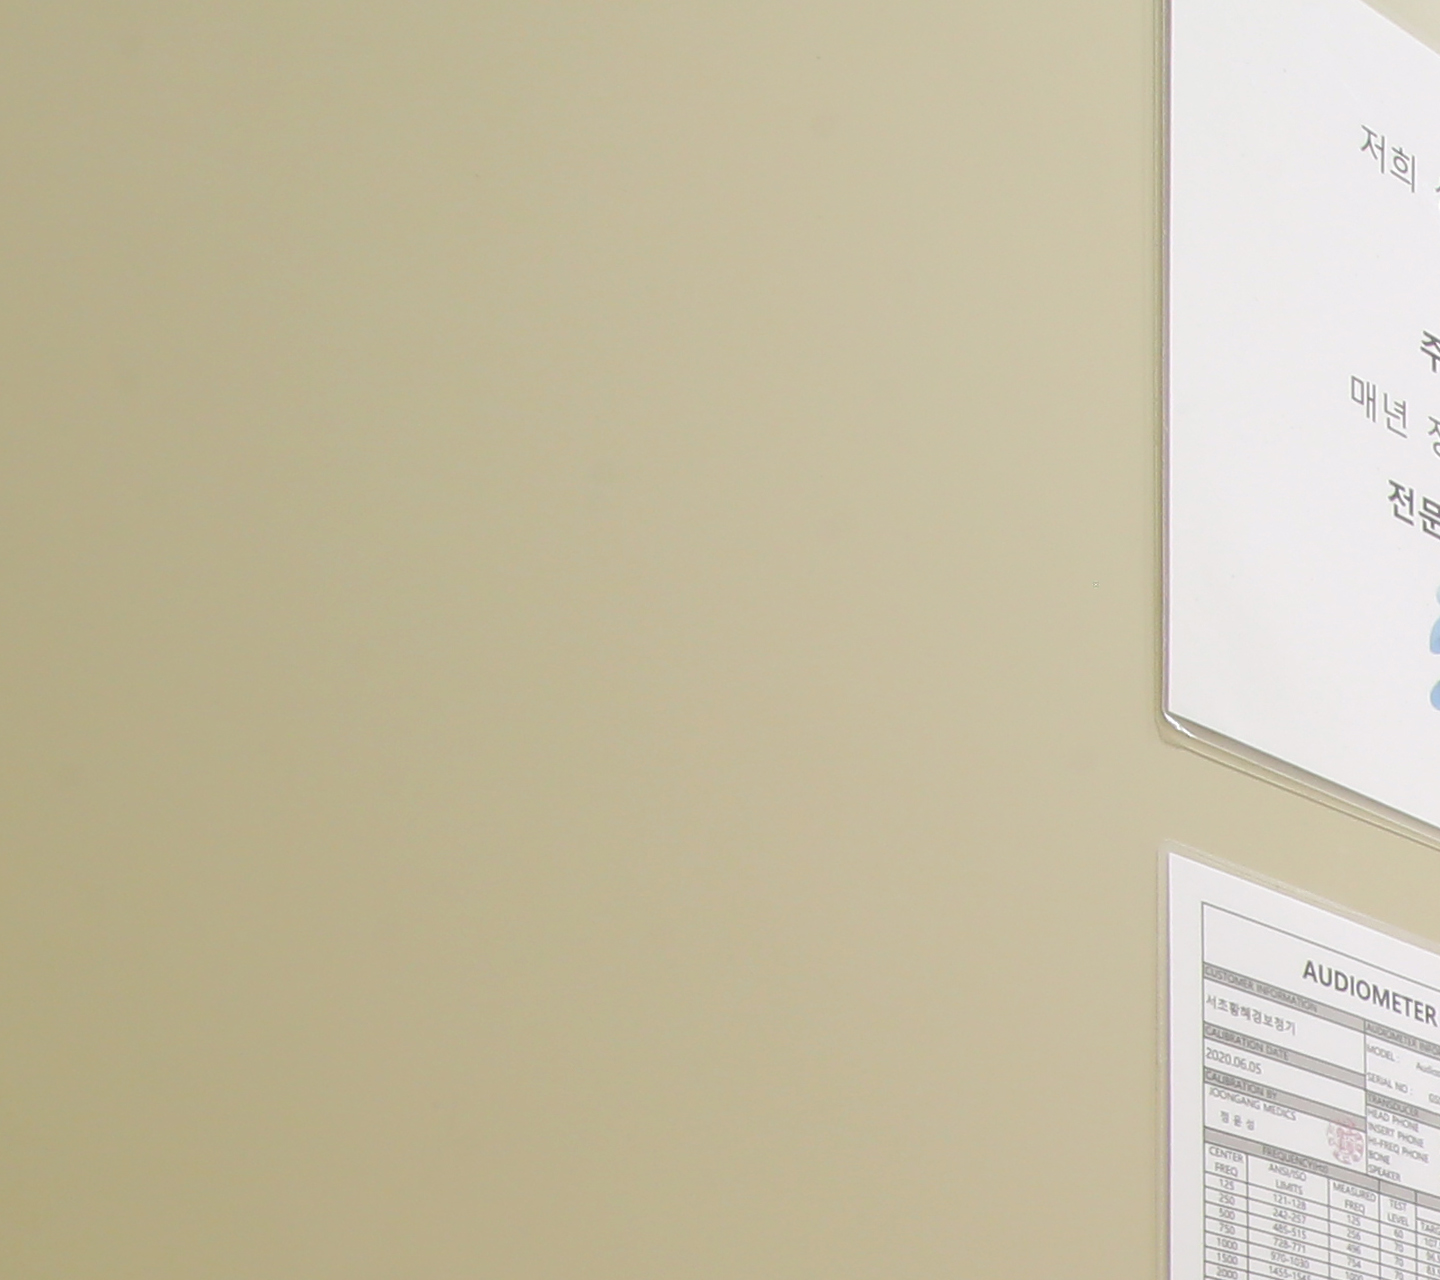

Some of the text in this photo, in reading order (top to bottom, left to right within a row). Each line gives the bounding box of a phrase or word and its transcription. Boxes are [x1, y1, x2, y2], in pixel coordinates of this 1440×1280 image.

[1360, 125, 1415, 193] 저희
[1351, 375, 1407, 439] 매년
[1206, 965, 1318, 1012] CUSTOMER INFORMATION
[1302, 959, 1438, 1028] AUDIOMETER
[1206, 1025, 1289, 1061] CALIBRATION DATE
[1366, 1023, 1417, 1046] AUDIOMETER
[1206, 1047, 1262, 1075] 2020.06.05
[1367, 1044, 1395, 1062] MODEL
[1206, 1071, 1278, 1099] CALIBRATION BY
[1367, 1072, 1392, 1089] SERIAL
[1395, 1082, 1408, 1094] NO
[1209, 1087, 1297, 1121] JOONGANG MEDICS
[1366, 1094, 1419, 1117] TRANSDUCER
[1367, 1109, 1419, 1132] HEAD PHONE
[1367, 1123, 1395, 1139] INSERT
[1397, 1133, 1424, 1148] PHONE
[1367, 1150, 1390, 1165] BONE
[1402, 1147, 1429, 1163] PHONE
[1209, 1146, 1244, 1163] CENTER
[1333, 1182, 1377, 1202] MEASURED
[1390, 1199, 1407, 1212] TEST
[1219, 1179, 1235, 1191] 125
[1367, 1165, 1401, 1183] SPEAKER
[1214, 1162, 1238, 1178] FREQ
[1275, 1180, 1303, 1196] LIMITS
[1344, 1200, 1366, 1215] FREQ
[1387, 1213, 1410, 1227] LEVEL
[1219, 1194, 1235, 1206] 250
[1219, 1209, 1236, 1221] 500
[1219, 1223, 1236, 1236] 750
[1217, 1238, 1238, 1251] 1000
[1217, 1253, 1238, 1266] 1500
[1216, 1268, 1238, 1280] 2000
